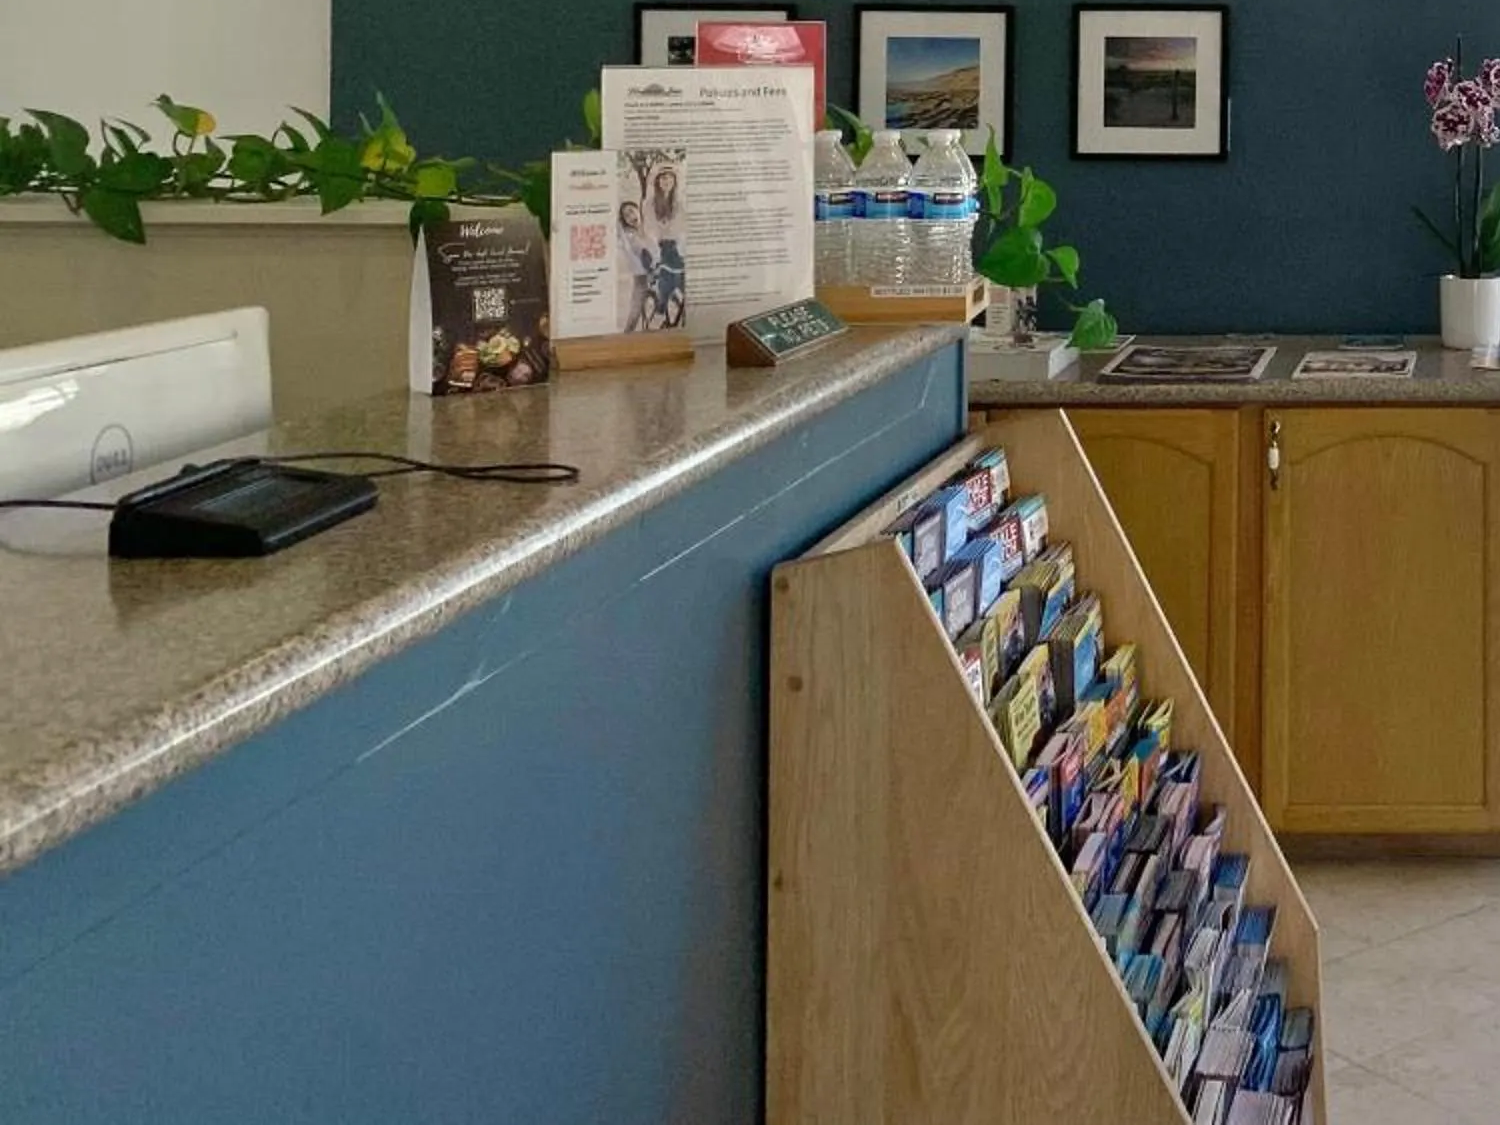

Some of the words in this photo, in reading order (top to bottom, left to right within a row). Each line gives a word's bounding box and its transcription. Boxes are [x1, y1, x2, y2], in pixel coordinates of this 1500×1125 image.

[741, 86, 761, 97] and
[763, 86, 787, 97] Fees
[459, 221, 504, 239] Welcome
[96, 449, 128, 472] DELL
